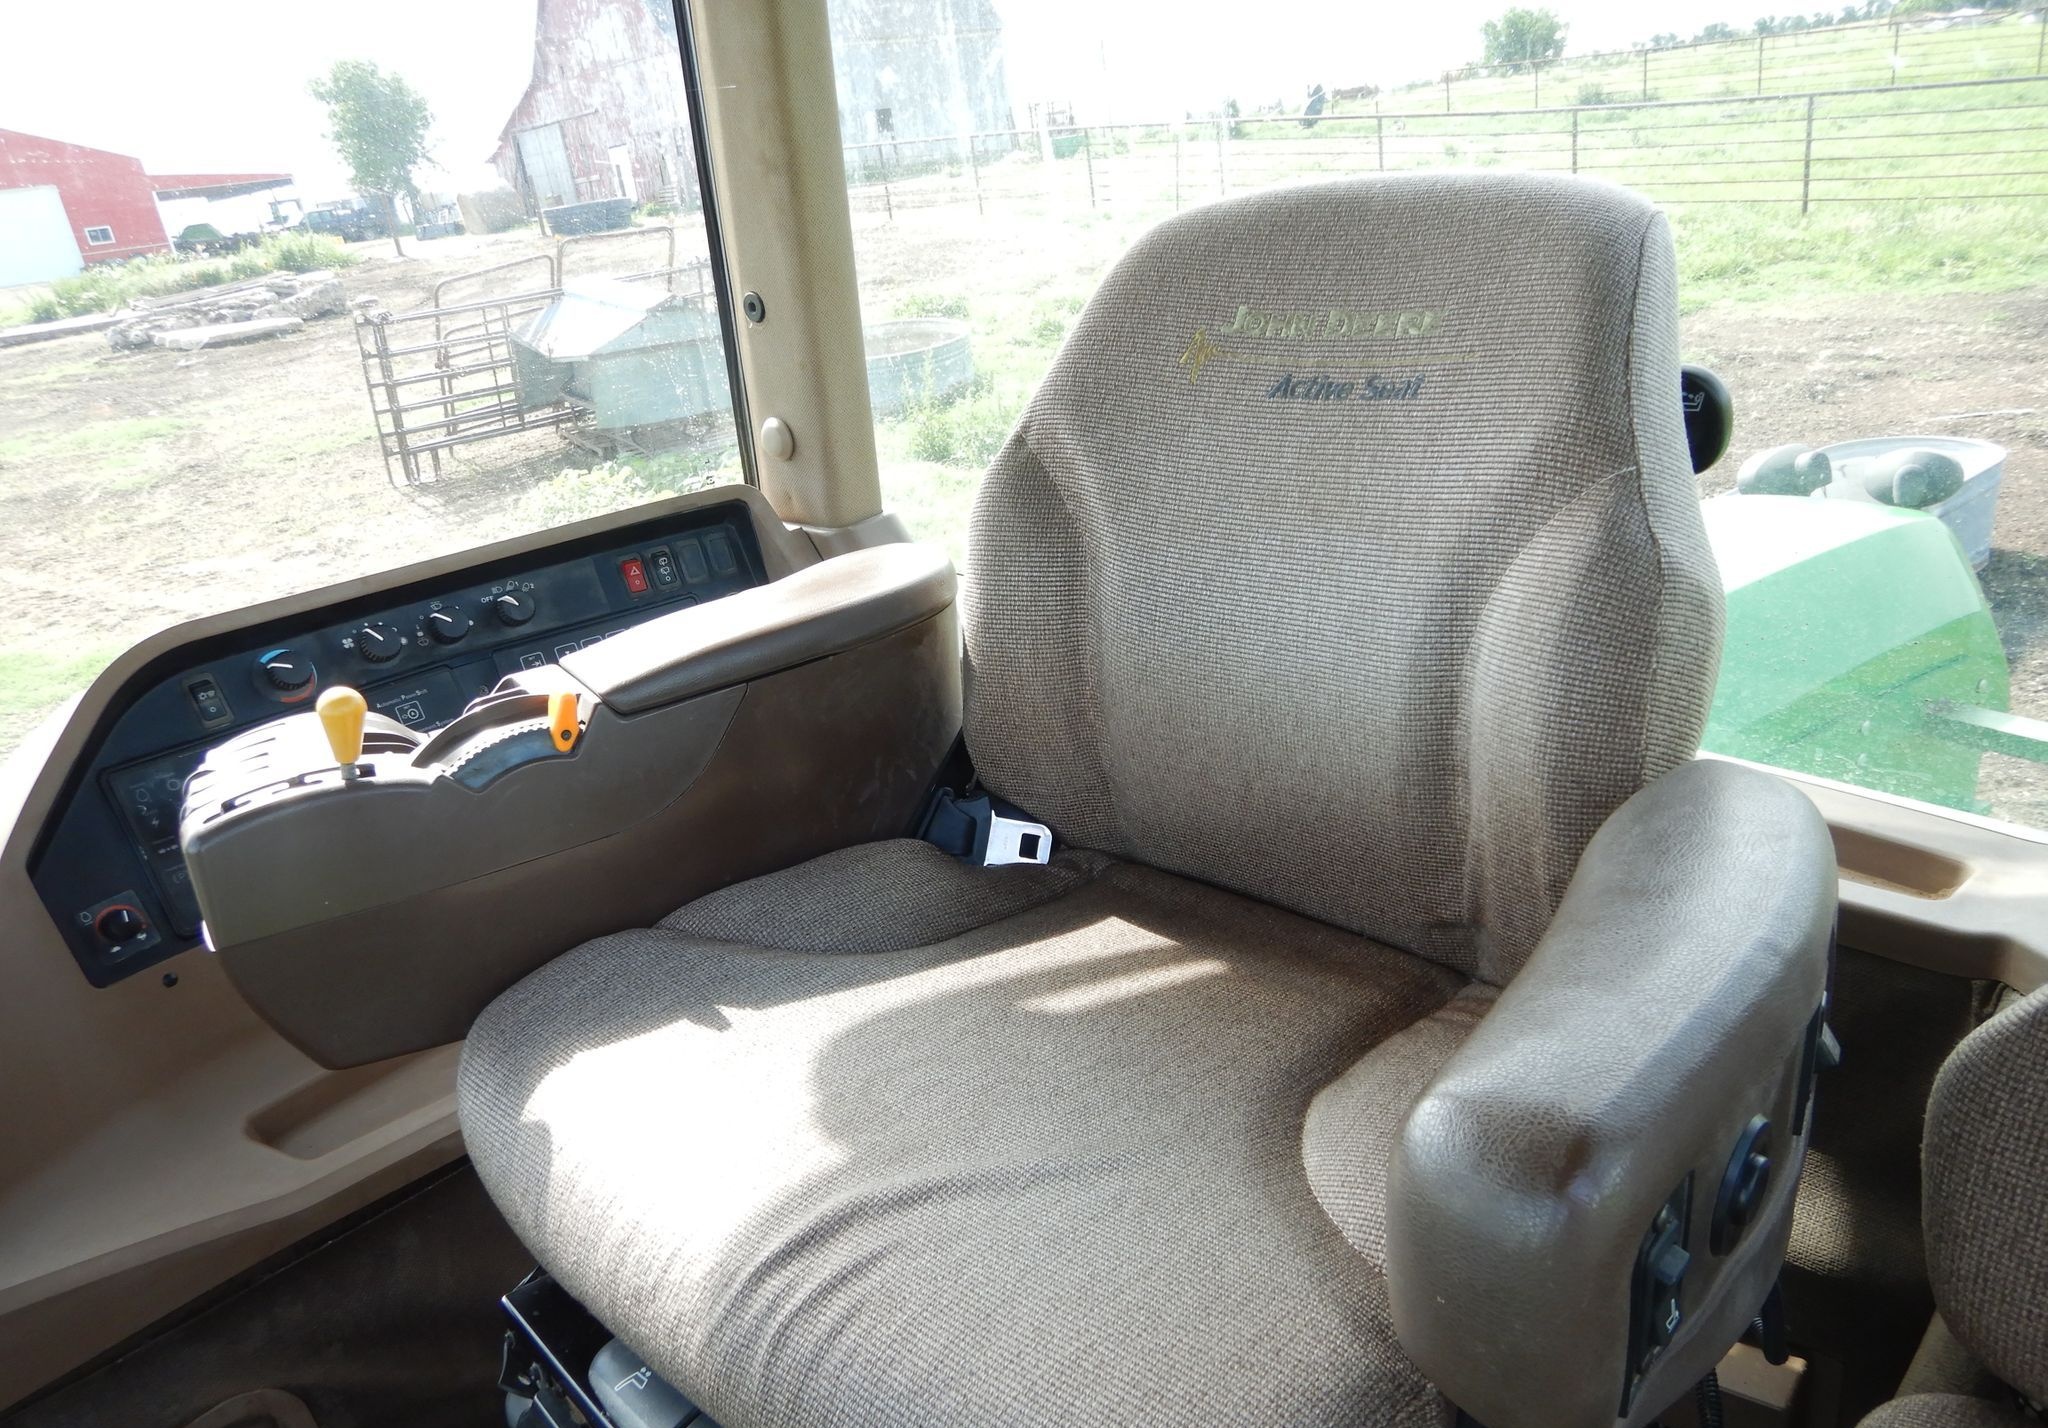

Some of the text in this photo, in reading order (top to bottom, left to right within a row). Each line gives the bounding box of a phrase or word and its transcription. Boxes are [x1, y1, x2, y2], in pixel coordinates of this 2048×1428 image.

[1220, 304, 1317, 337] JOHN
[1267, 373, 1425, 400] Active Seat
